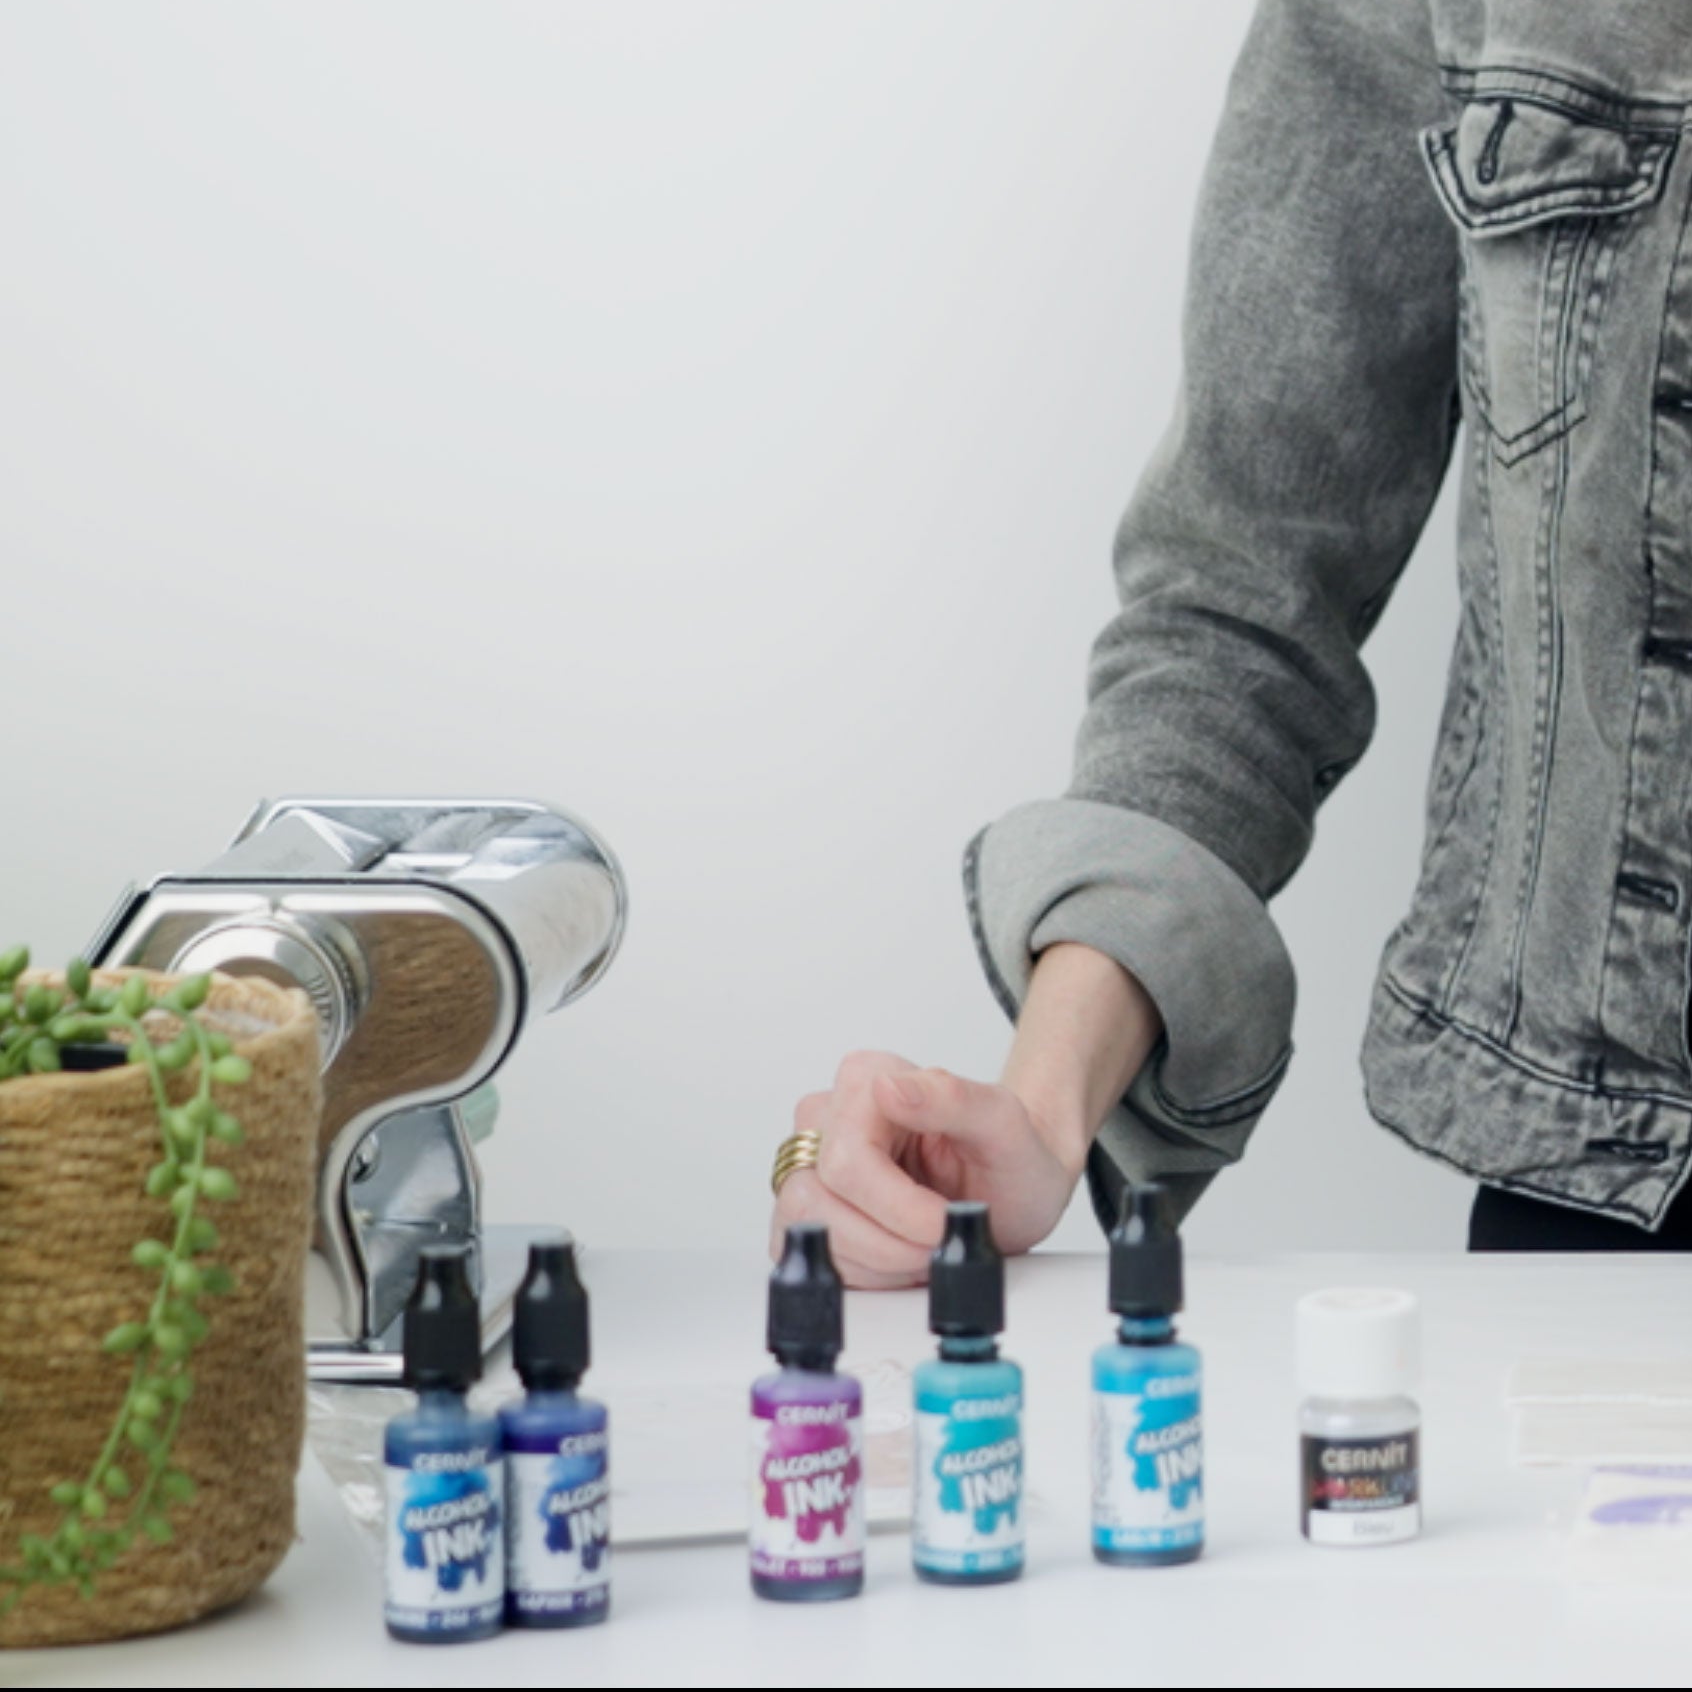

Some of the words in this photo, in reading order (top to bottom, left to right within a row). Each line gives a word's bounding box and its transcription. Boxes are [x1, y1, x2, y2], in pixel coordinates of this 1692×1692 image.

[768, 1447, 850, 1480] ALCOHOL
[783, 1472, 845, 1517] INK
[423, 1520, 487, 1568] INK
